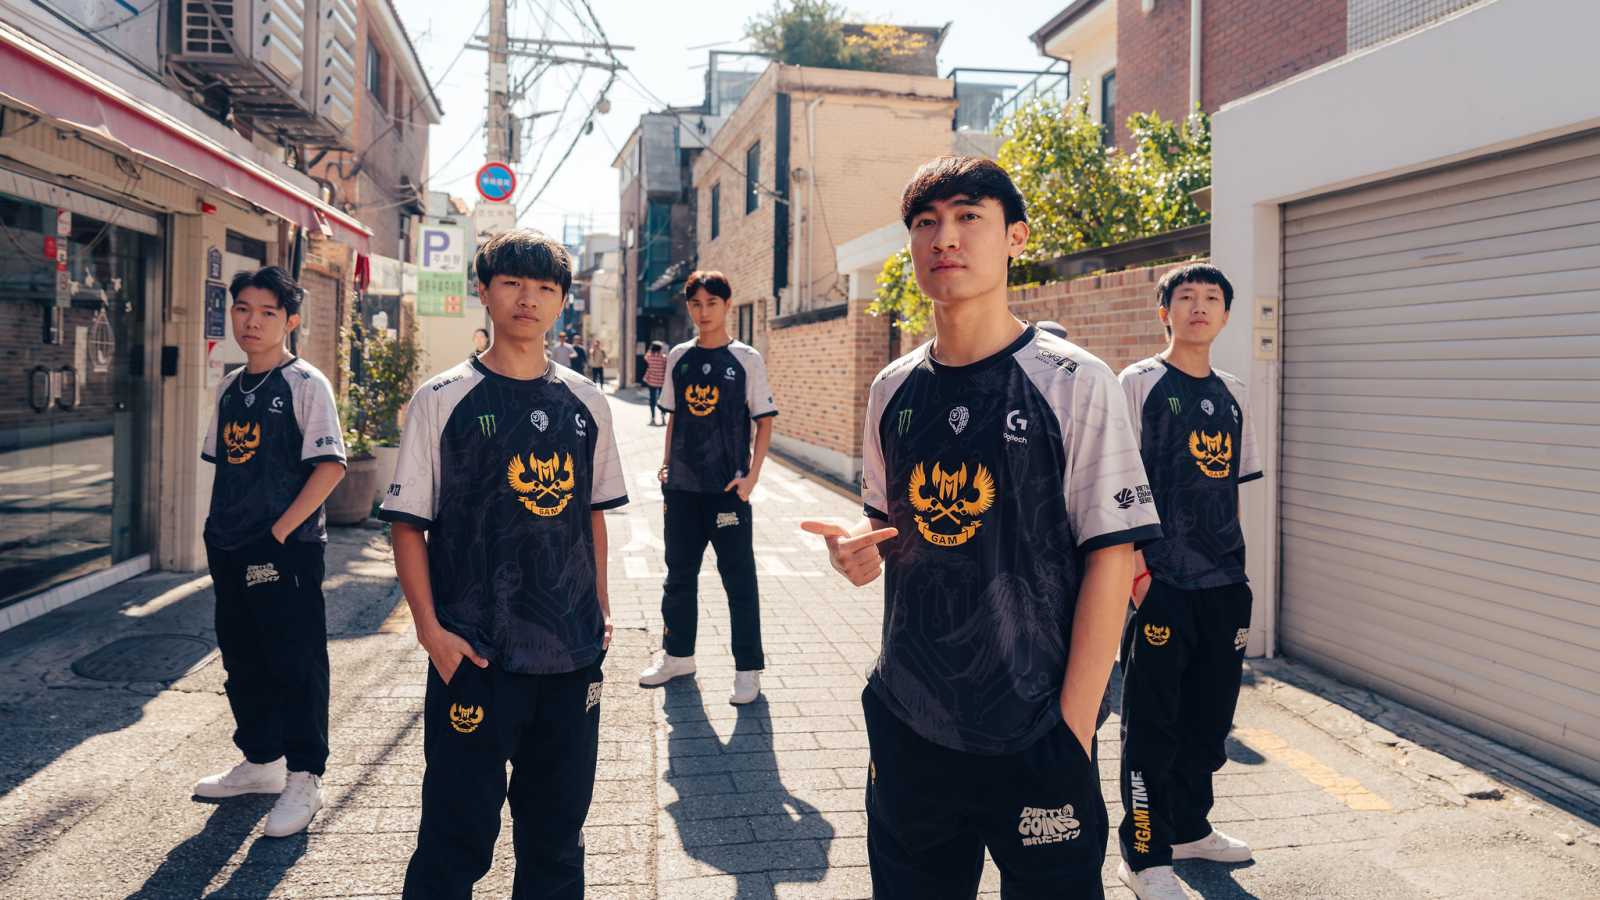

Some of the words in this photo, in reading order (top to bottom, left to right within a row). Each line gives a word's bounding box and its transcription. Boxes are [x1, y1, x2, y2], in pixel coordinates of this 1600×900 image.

[424, 230, 450, 267] P
[931, 534, 958, 545] GAM
[1020, 806, 1062, 818] DIRTY
[1018, 815, 1081, 836] COINS
